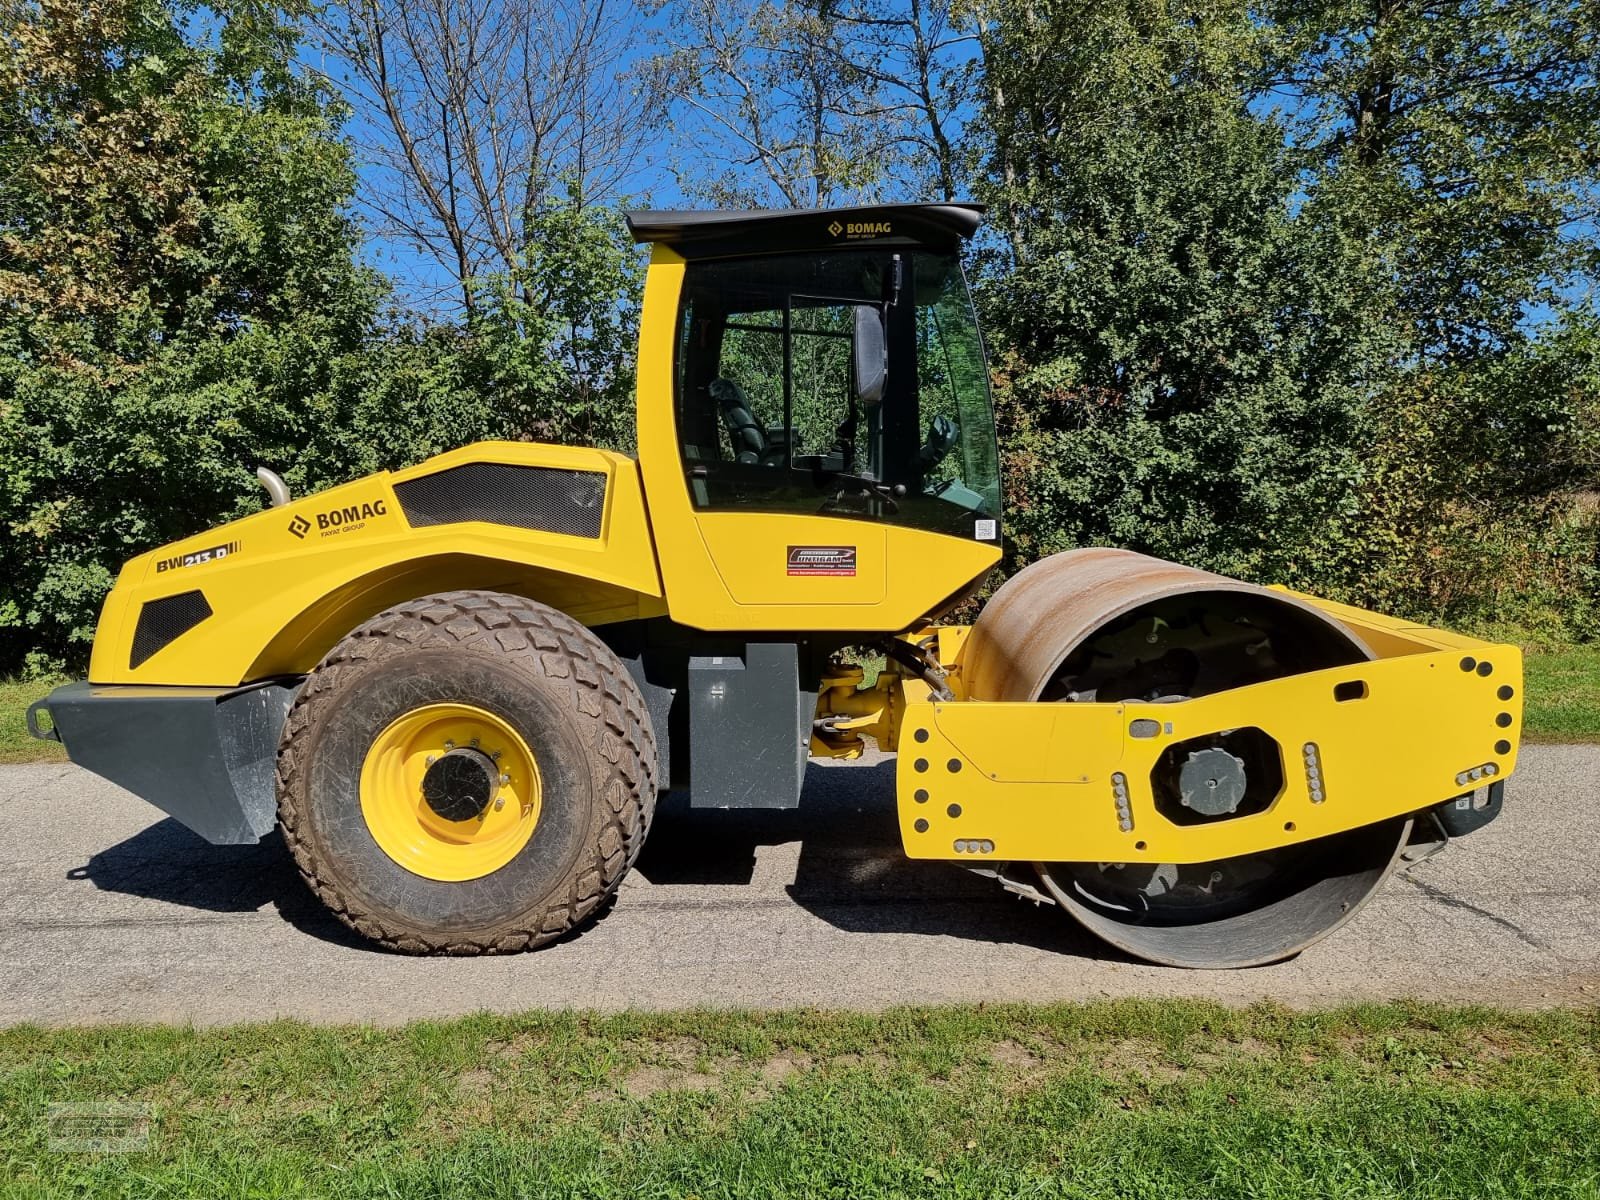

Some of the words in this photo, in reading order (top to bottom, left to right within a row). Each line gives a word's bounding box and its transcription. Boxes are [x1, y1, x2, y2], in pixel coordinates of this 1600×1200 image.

[847, 222, 891, 234] BOMAG
[316, 500, 387, 529] BOMAG
[321, 529, 340, 537] FAYAT
[342, 522, 366, 532] GROUP
